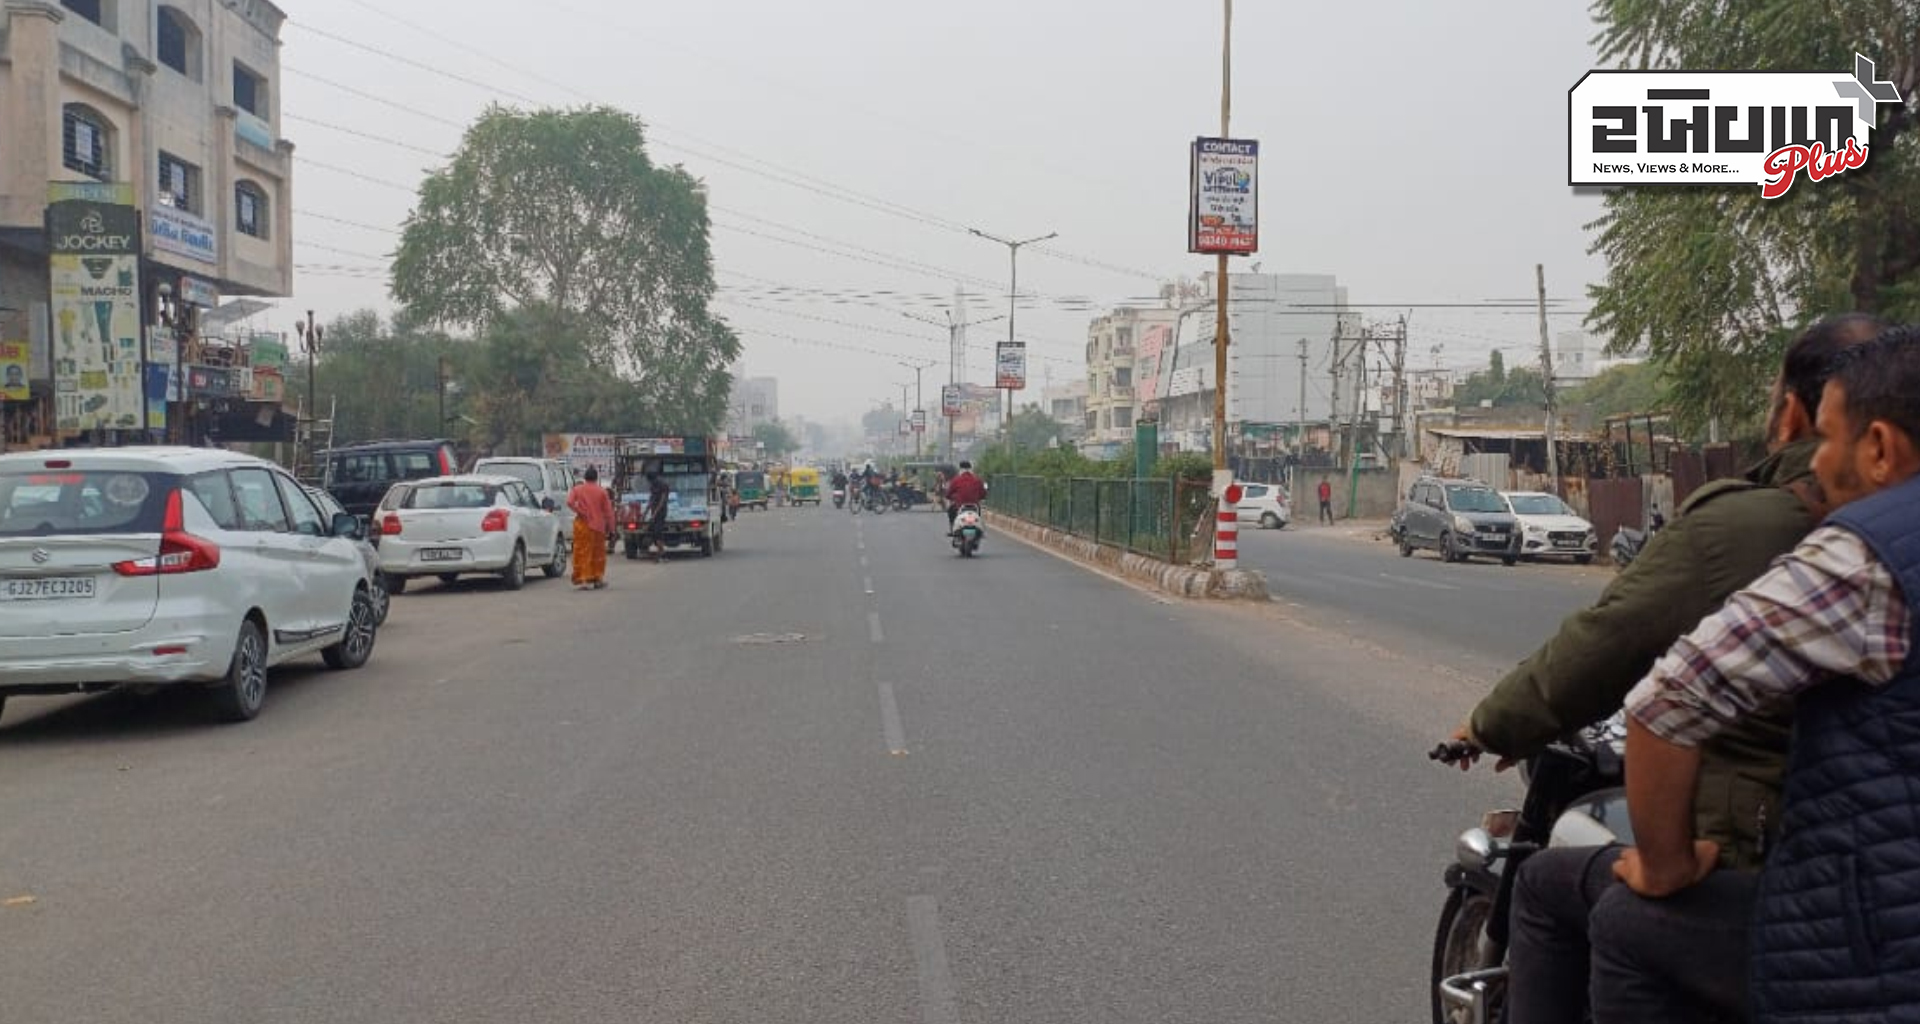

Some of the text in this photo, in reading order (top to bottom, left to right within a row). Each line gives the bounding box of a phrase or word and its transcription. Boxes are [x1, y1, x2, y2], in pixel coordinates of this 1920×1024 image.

[1203, 142, 1251, 154] CONTACT
[57, 235, 131, 250] JOCKEY
[81, 286, 132, 296] MACHO
